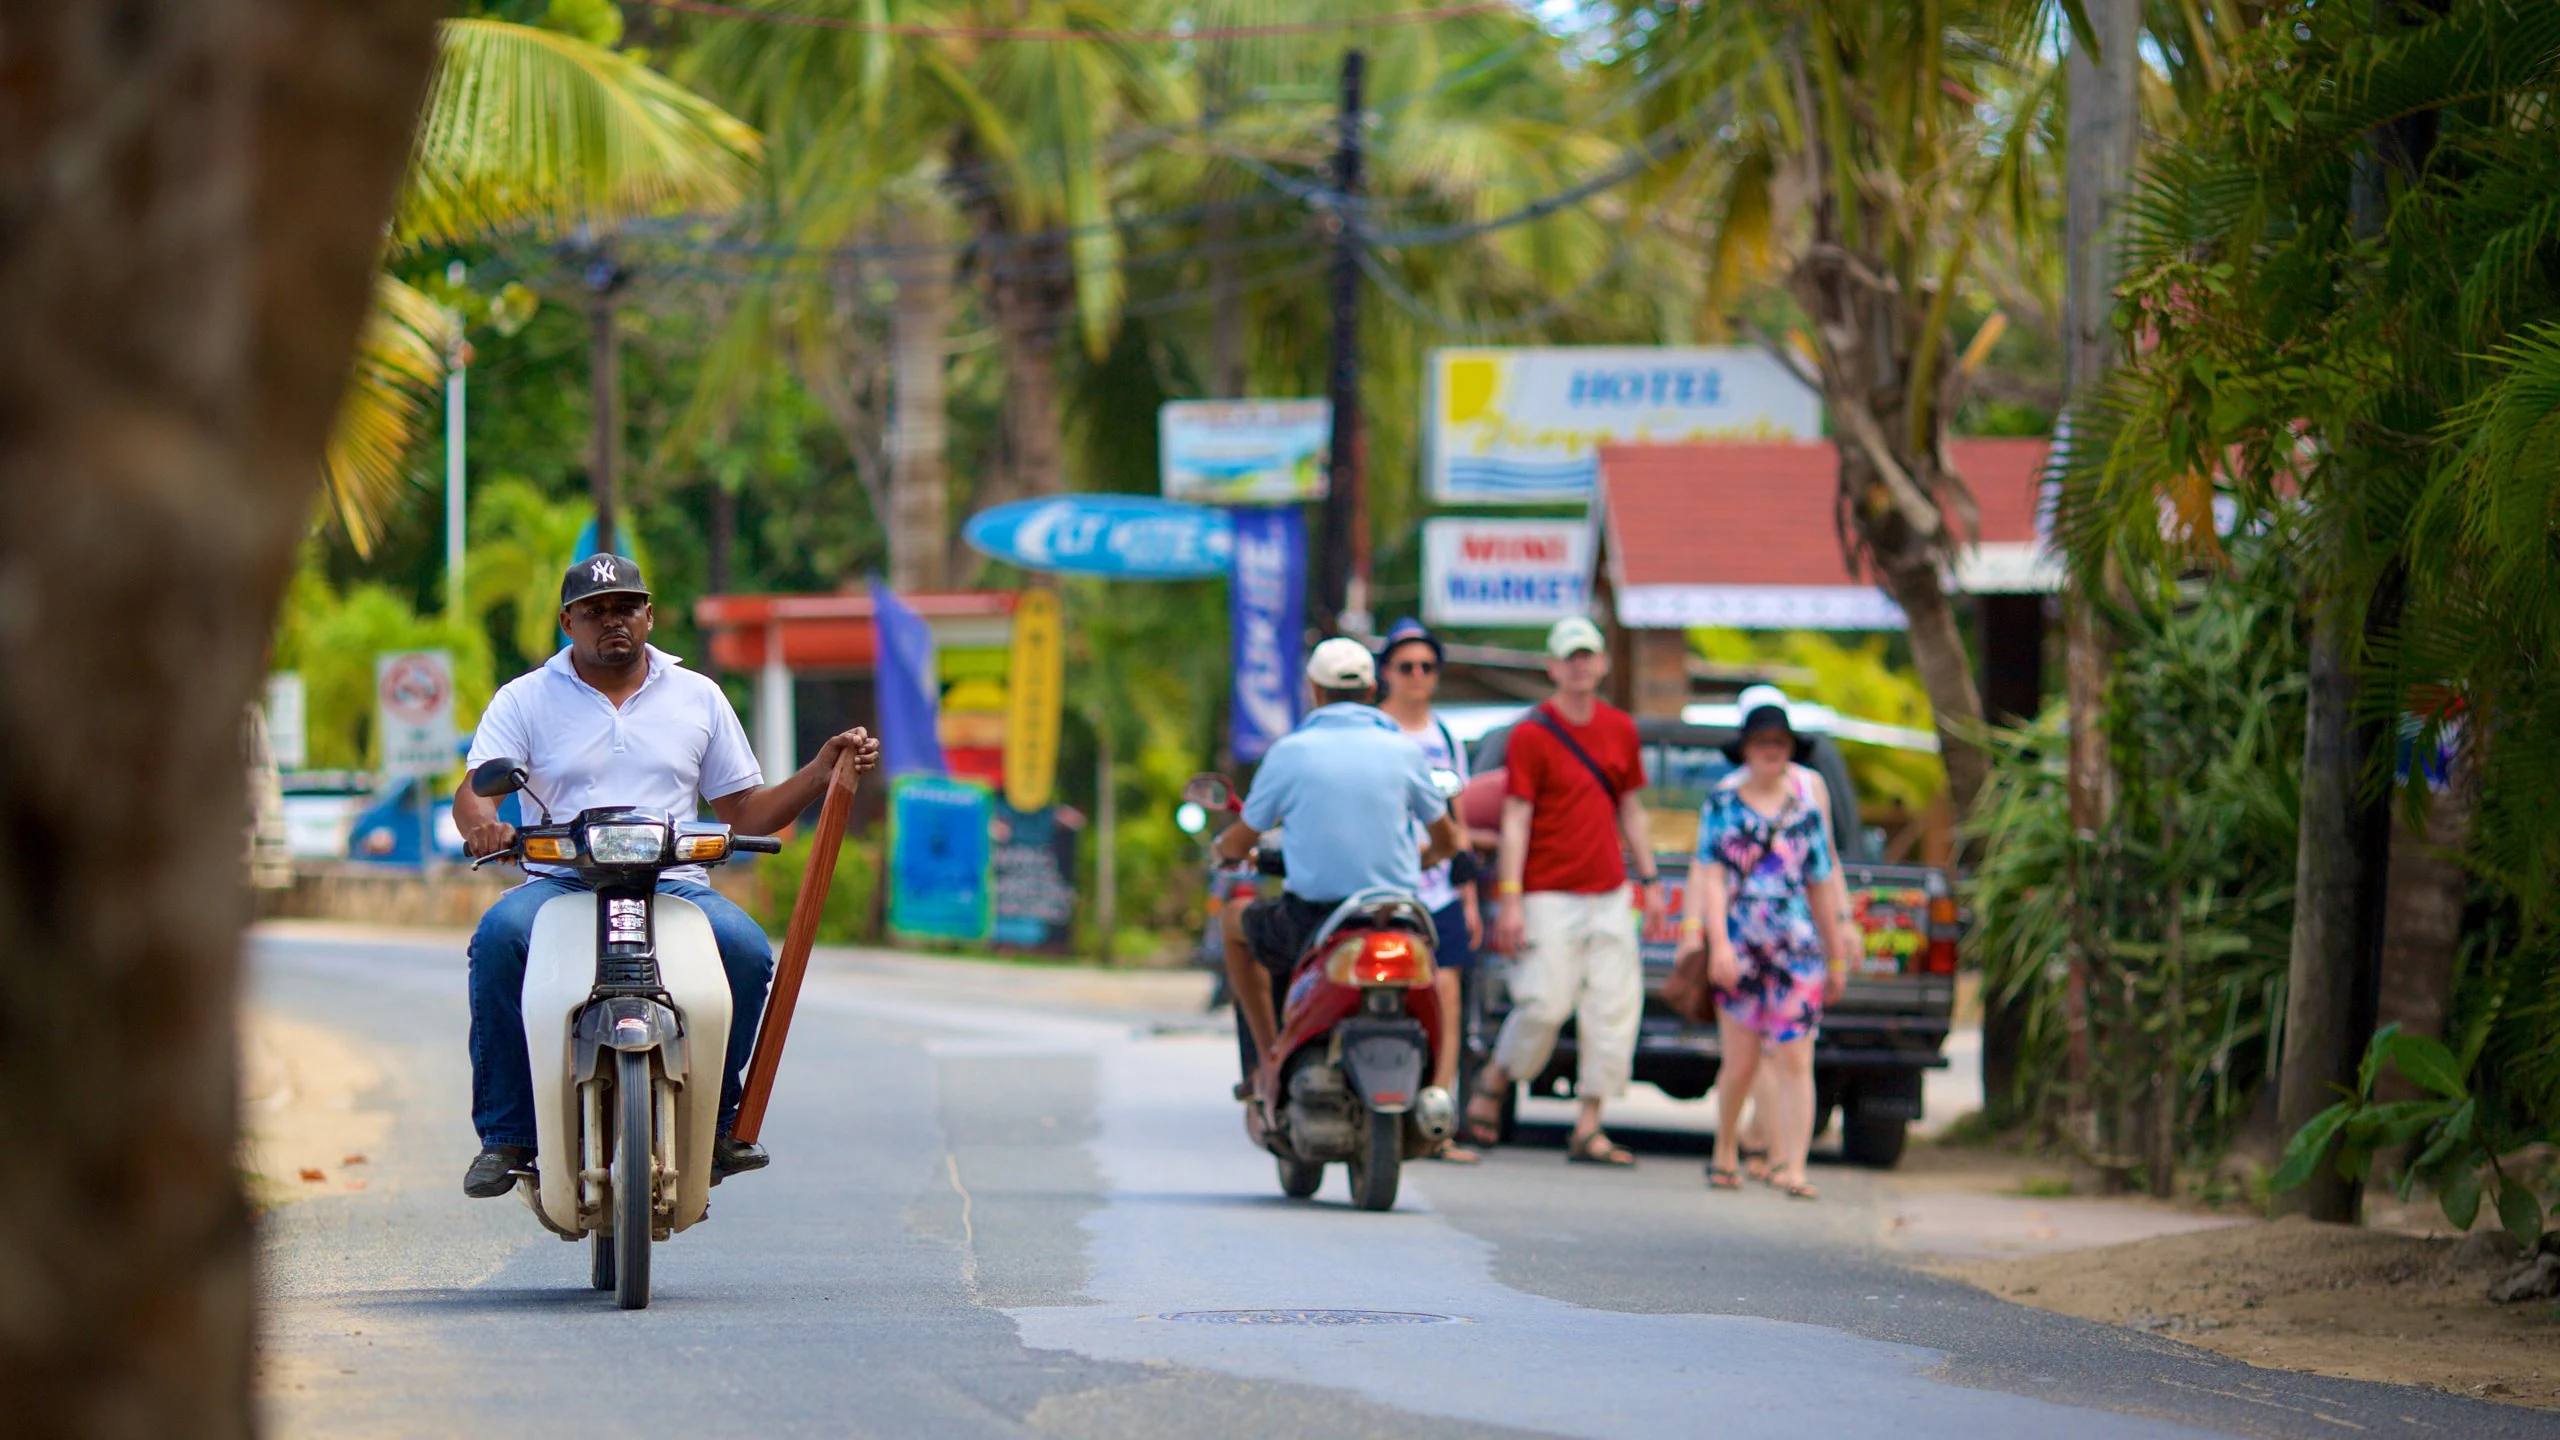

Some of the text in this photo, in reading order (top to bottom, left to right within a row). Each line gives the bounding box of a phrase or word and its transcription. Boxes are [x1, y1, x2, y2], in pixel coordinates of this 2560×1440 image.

[1568, 368, 1724, 407] HOTEL
[1461, 533, 1567, 562] MINI
[591, 560, 617, 583] NY
[1447, 573, 1586, 604] MARKET
